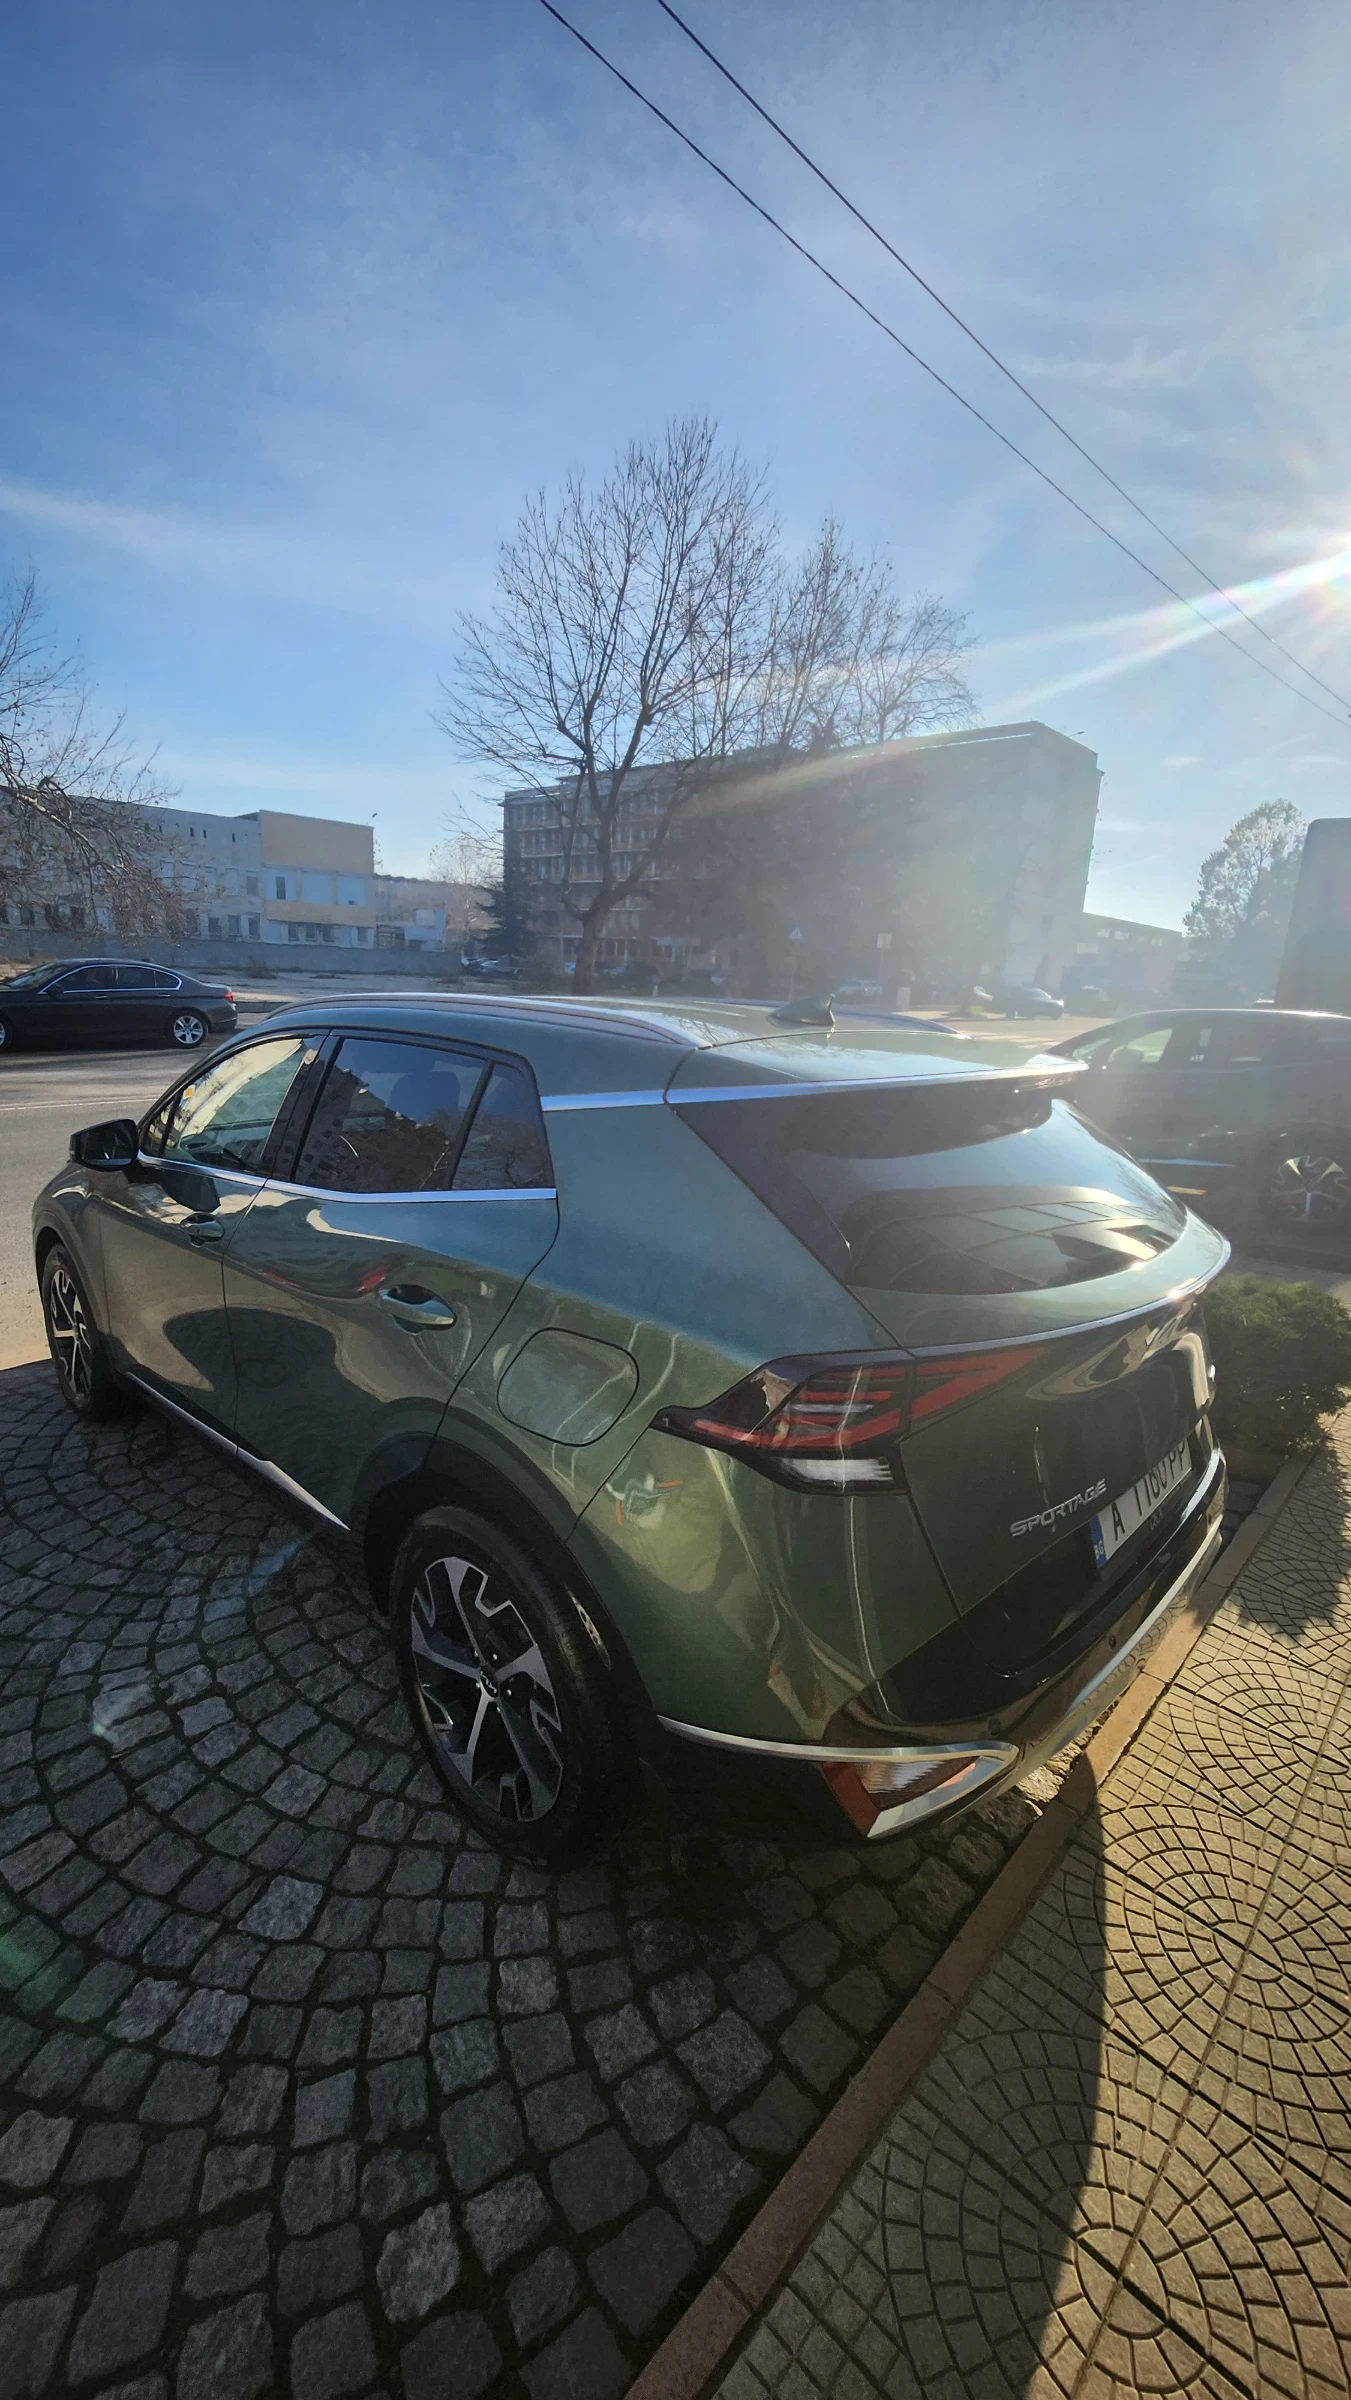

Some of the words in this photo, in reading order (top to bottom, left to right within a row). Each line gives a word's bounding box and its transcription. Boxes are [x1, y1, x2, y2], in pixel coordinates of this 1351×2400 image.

[1009, 1478, 1107, 1536] SPORTAGE
[1111, 1502, 1126, 1541] A
[1093, 1540, 1104, 1560] BG
